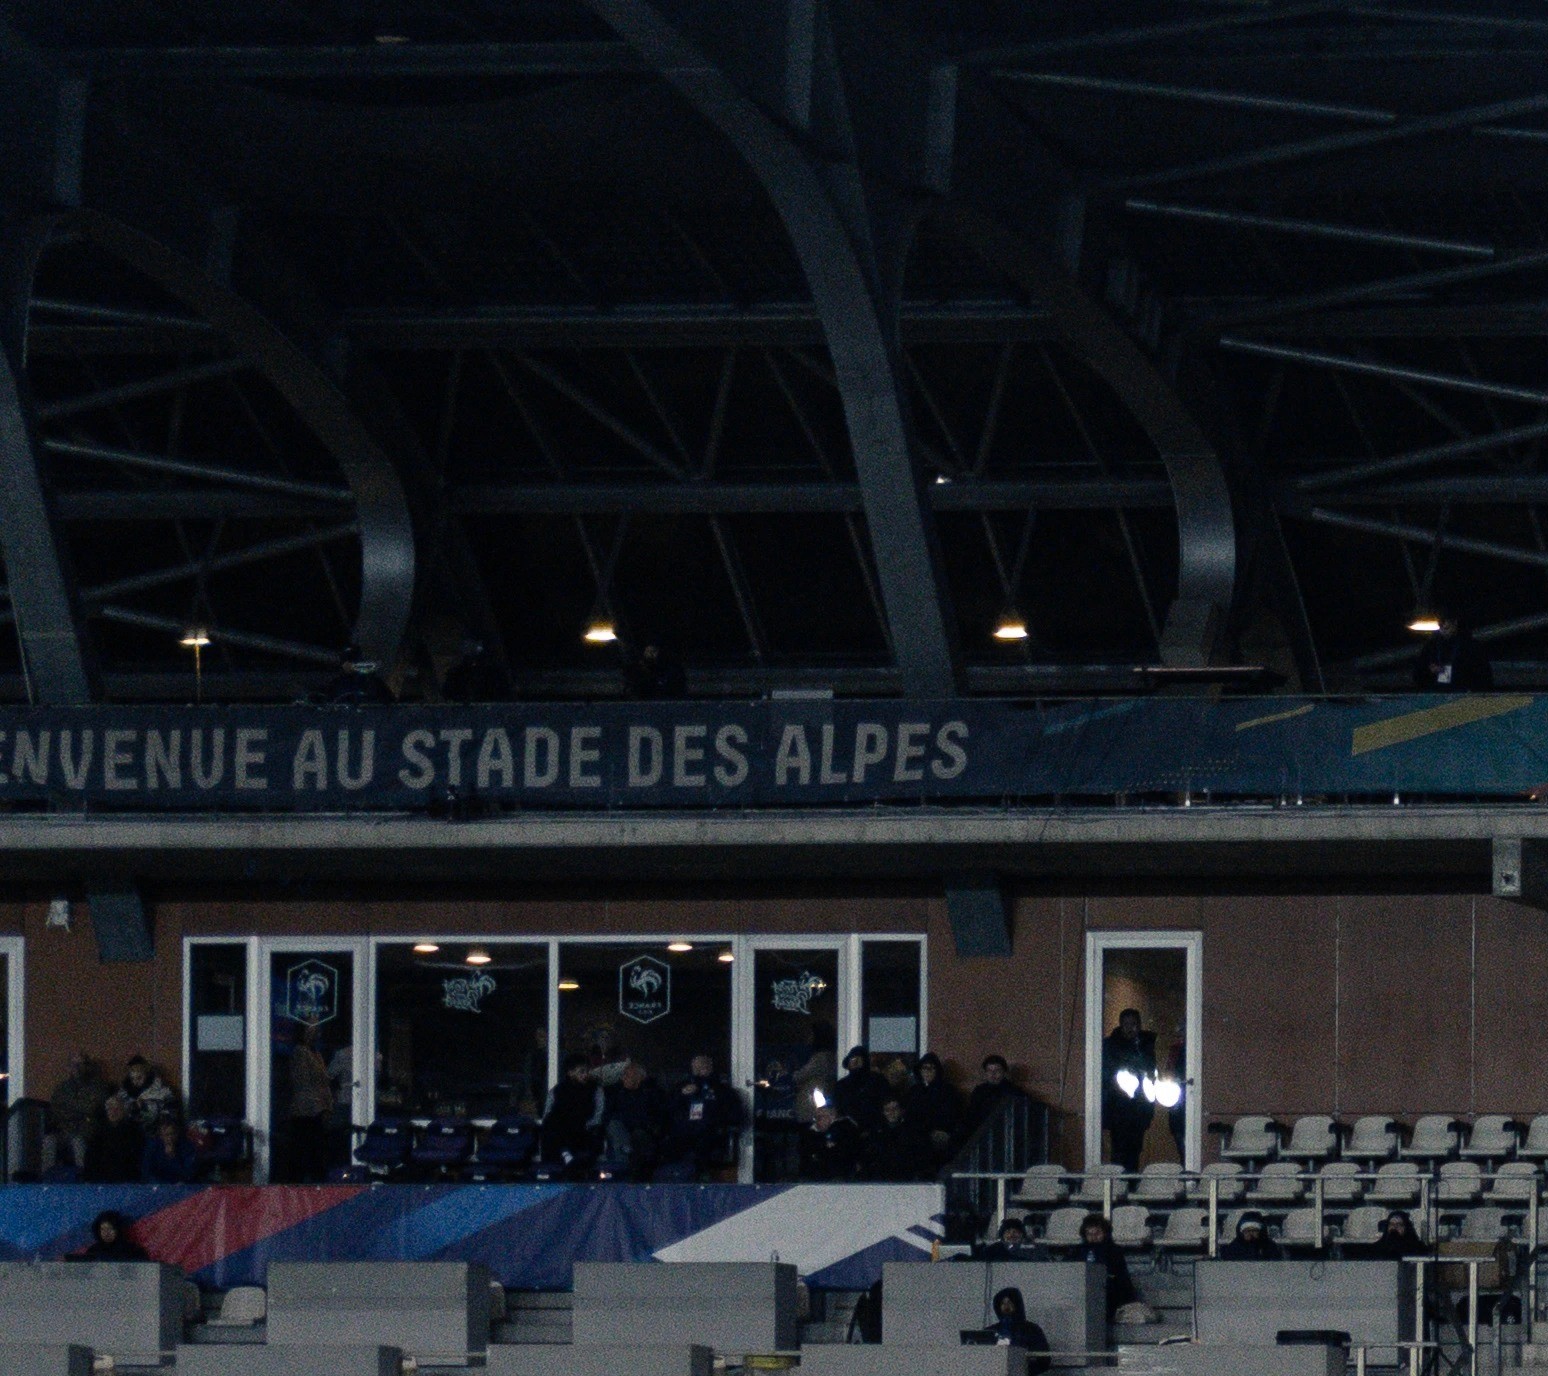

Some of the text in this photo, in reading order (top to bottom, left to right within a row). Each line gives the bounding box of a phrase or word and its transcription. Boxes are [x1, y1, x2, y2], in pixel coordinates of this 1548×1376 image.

[0, 721, 969, 791] NVENUE AU STADE DES ALPES
